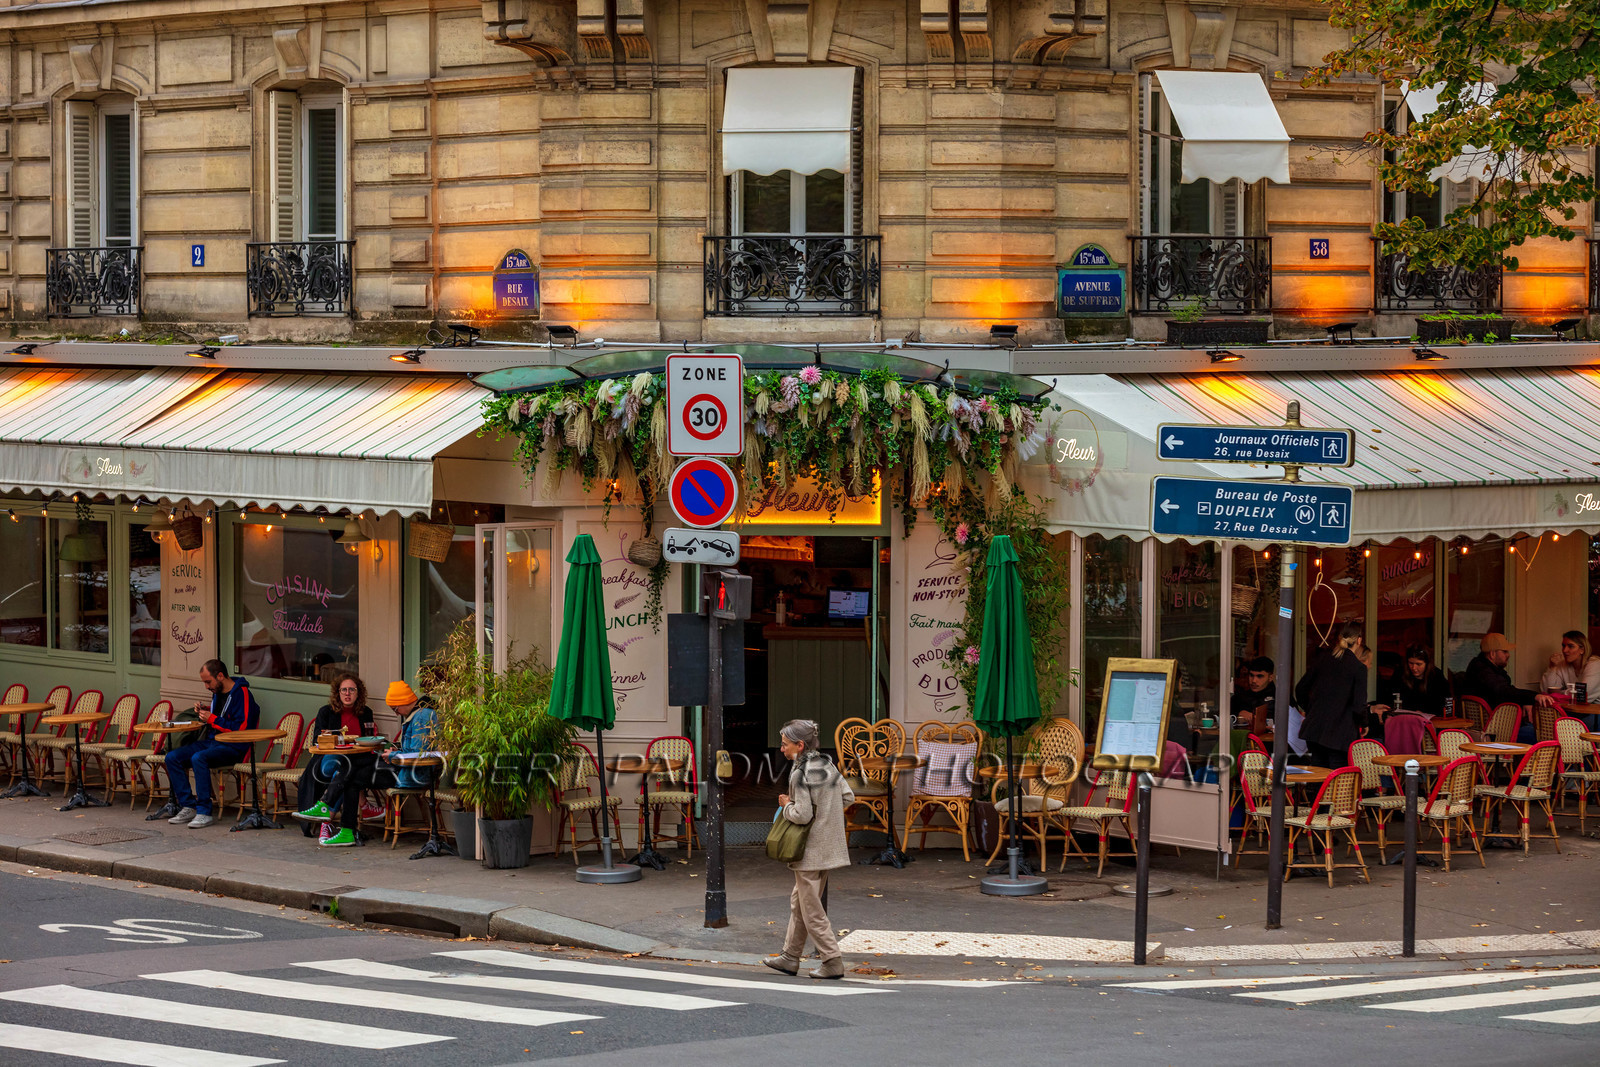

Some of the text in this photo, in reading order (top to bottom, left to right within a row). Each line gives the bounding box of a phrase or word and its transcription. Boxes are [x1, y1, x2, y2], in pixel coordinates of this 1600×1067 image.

[194, 246, 202, 265] 2
[1312, 241, 1328, 256] 38
[507, 283, 523, 294] RUE
[1074, 281, 1111, 292] AVENUE
[502, 296, 529, 306] DESAIX
[1063, 295, 1121, 306] DE SUFFREN
[682, 367, 727, 381] ZONE
[691, 407, 719, 427] 30
[1214, 432, 1320, 447] Journaux Officiels
[1056, 438, 1096, 463] Fleur
[1235, 449, 1252, 457] rue
[1256, 449, 1290, 459] Desaix
[96, 457, 124, 477] Fleur
[1215, 488, 1318, 504] Bureau de Poste
[1214, 504, 1277, 519] DUPLEIX
[1233, 522, 1255, 532] Rue
[1260, 523, 1300, 535] Desaix
[172, 564, 202, 579] SERVICE
[917, 575, 962, 588] SERVICE
[266, 574, 332, 609] CUISINE
[912, 588, 966, 602] NON-STOP
[1174, 591, 1206, 608] BIO
[171, 603, 202, 613] AFTER WORK
[272, 609, 324, 634] Familiale
[605, 612, 649, 631] UNCH
[909, 613, 937, 629] Fait
[171, 621, 204, 645] Cocktails
[611, 670, 646, 684] inner
[918, 673, 959, 693] BIO
[38, 918, 264, 944] 30
